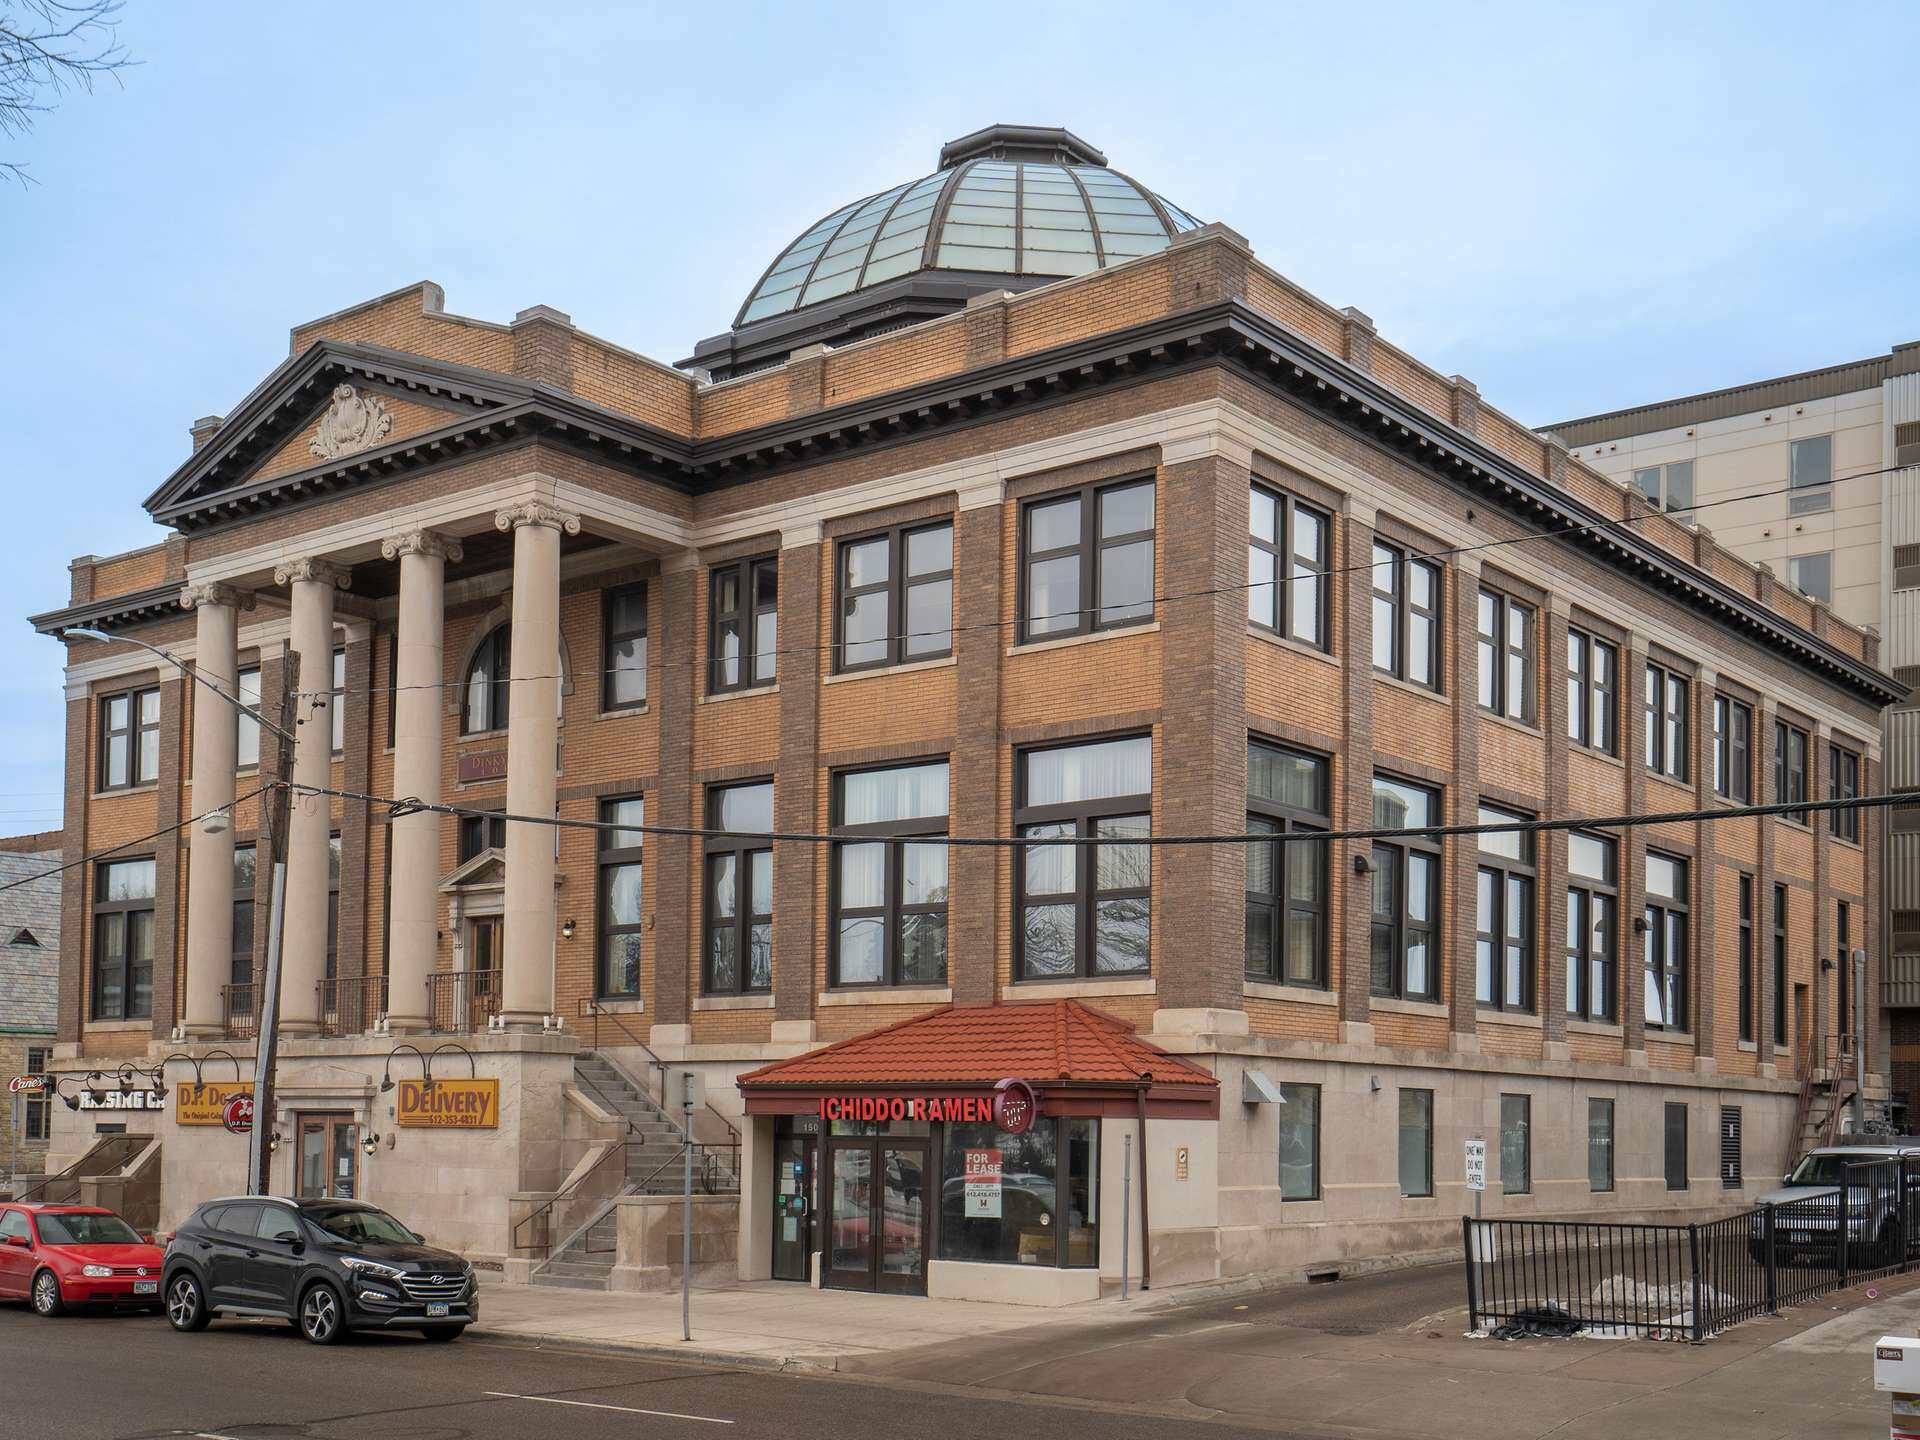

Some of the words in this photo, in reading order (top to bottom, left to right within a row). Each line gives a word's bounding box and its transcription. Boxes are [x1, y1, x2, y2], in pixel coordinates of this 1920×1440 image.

[9, 1077, 45, 1092] Cane's
[819, 1097, 905, 1121] ICHIDDO
[913, 1097, 992, 1121] RAMEN
[1466, 1145, 1475, 1156] ONE
[1476, 1146, 1484, 1156] WAY
[966, 1153, 989, 1164] FOR
[966, 1163, 1002, 1174] LEASE
[1467, 1159, 1474, 1170] DO
[1475, 1160, 1483, 1170] NOT
[1468, 1174, 1481, 1184] ENTER
